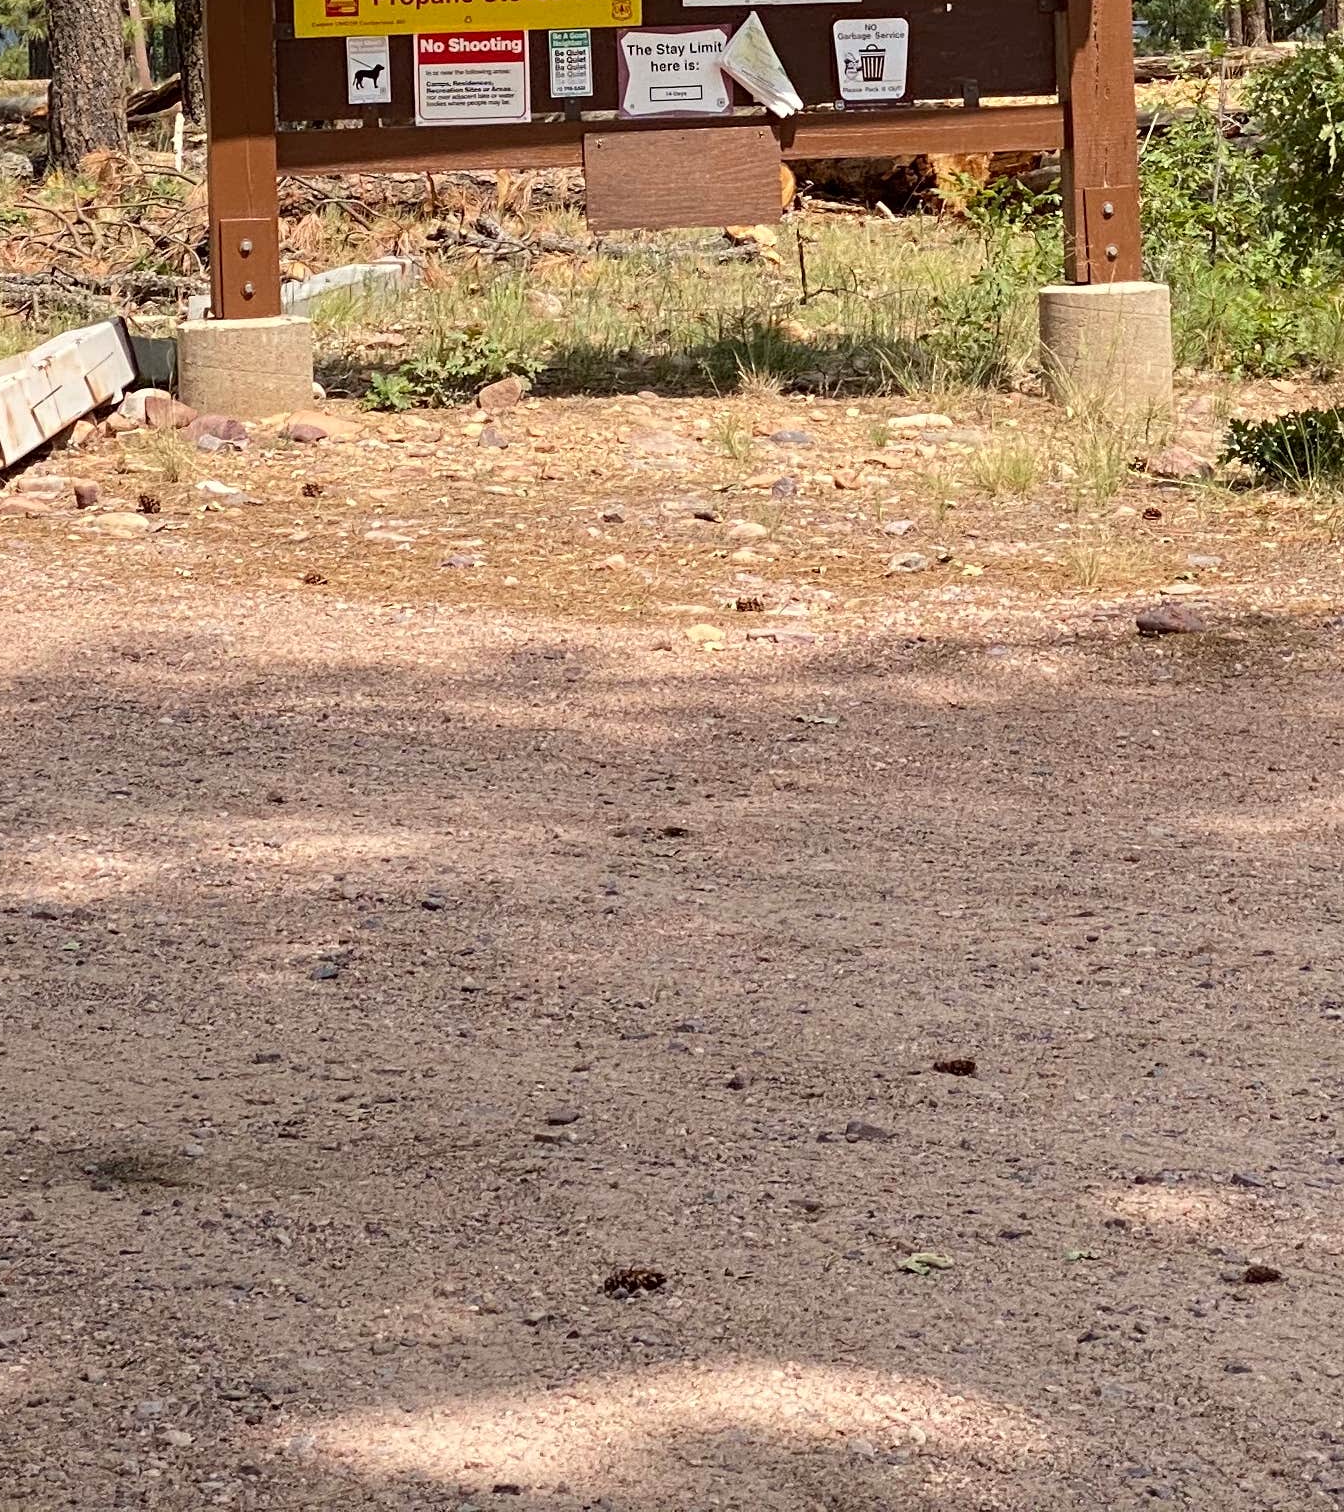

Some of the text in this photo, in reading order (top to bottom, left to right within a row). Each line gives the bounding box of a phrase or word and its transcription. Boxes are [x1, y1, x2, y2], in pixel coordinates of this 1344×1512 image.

[837, 32, 905, 41] Garbage Service
[420, 37, 523, 53] No Shooting
[627, 41, 723, 57] The Stay Limit
[566, 49, 586, 57] Quiet
[566, 56, 586, 64] Quiet
[651, 60, 700, 72] here is:
